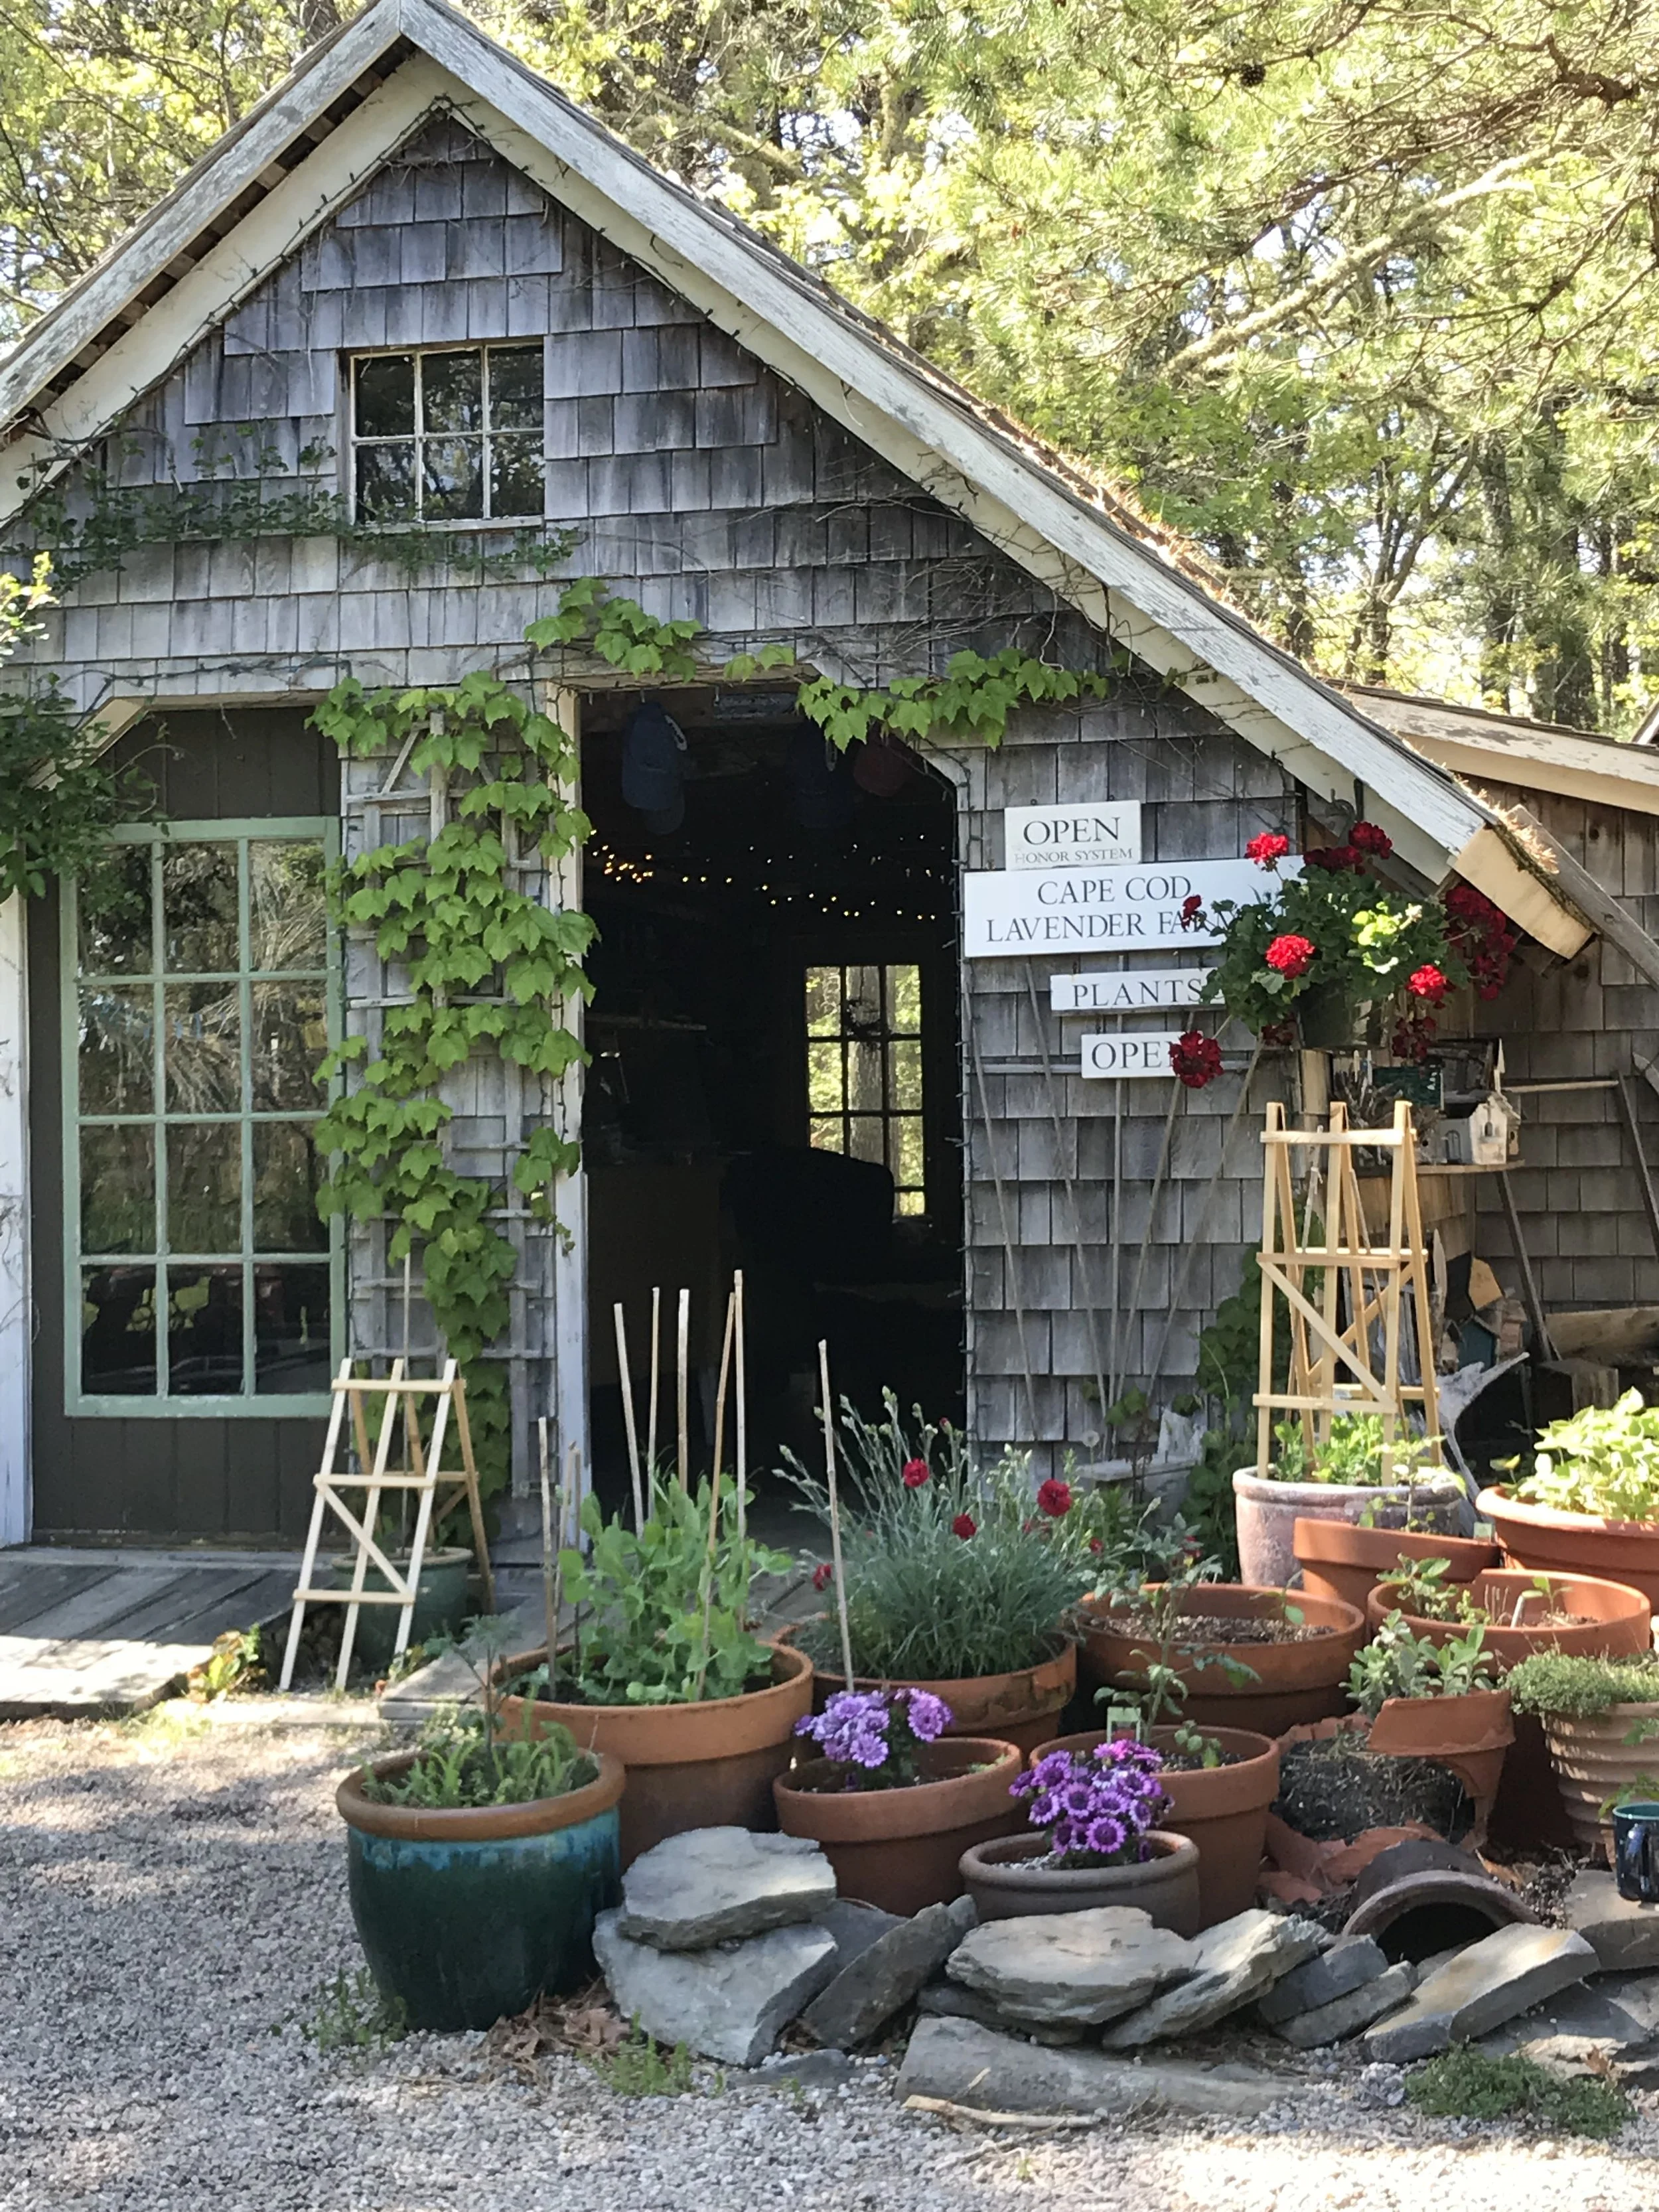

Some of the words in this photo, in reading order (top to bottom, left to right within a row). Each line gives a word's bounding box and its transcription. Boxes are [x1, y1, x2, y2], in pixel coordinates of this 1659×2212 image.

[1023, 817, 1121, 846] OPEN
[1015, 850, 1070, 864] HONOR
[1075, 848, 1132, 862] SYSTEM
[1037, 879, 1115, 905] CAPE
[1125, 875, 1191, 901] COD
[987, 912, 1146, 942] LAVENDER
[1072, 978, 1202, 1007] PLANTS
[1092, 1041, 1174, 1070] OPE
